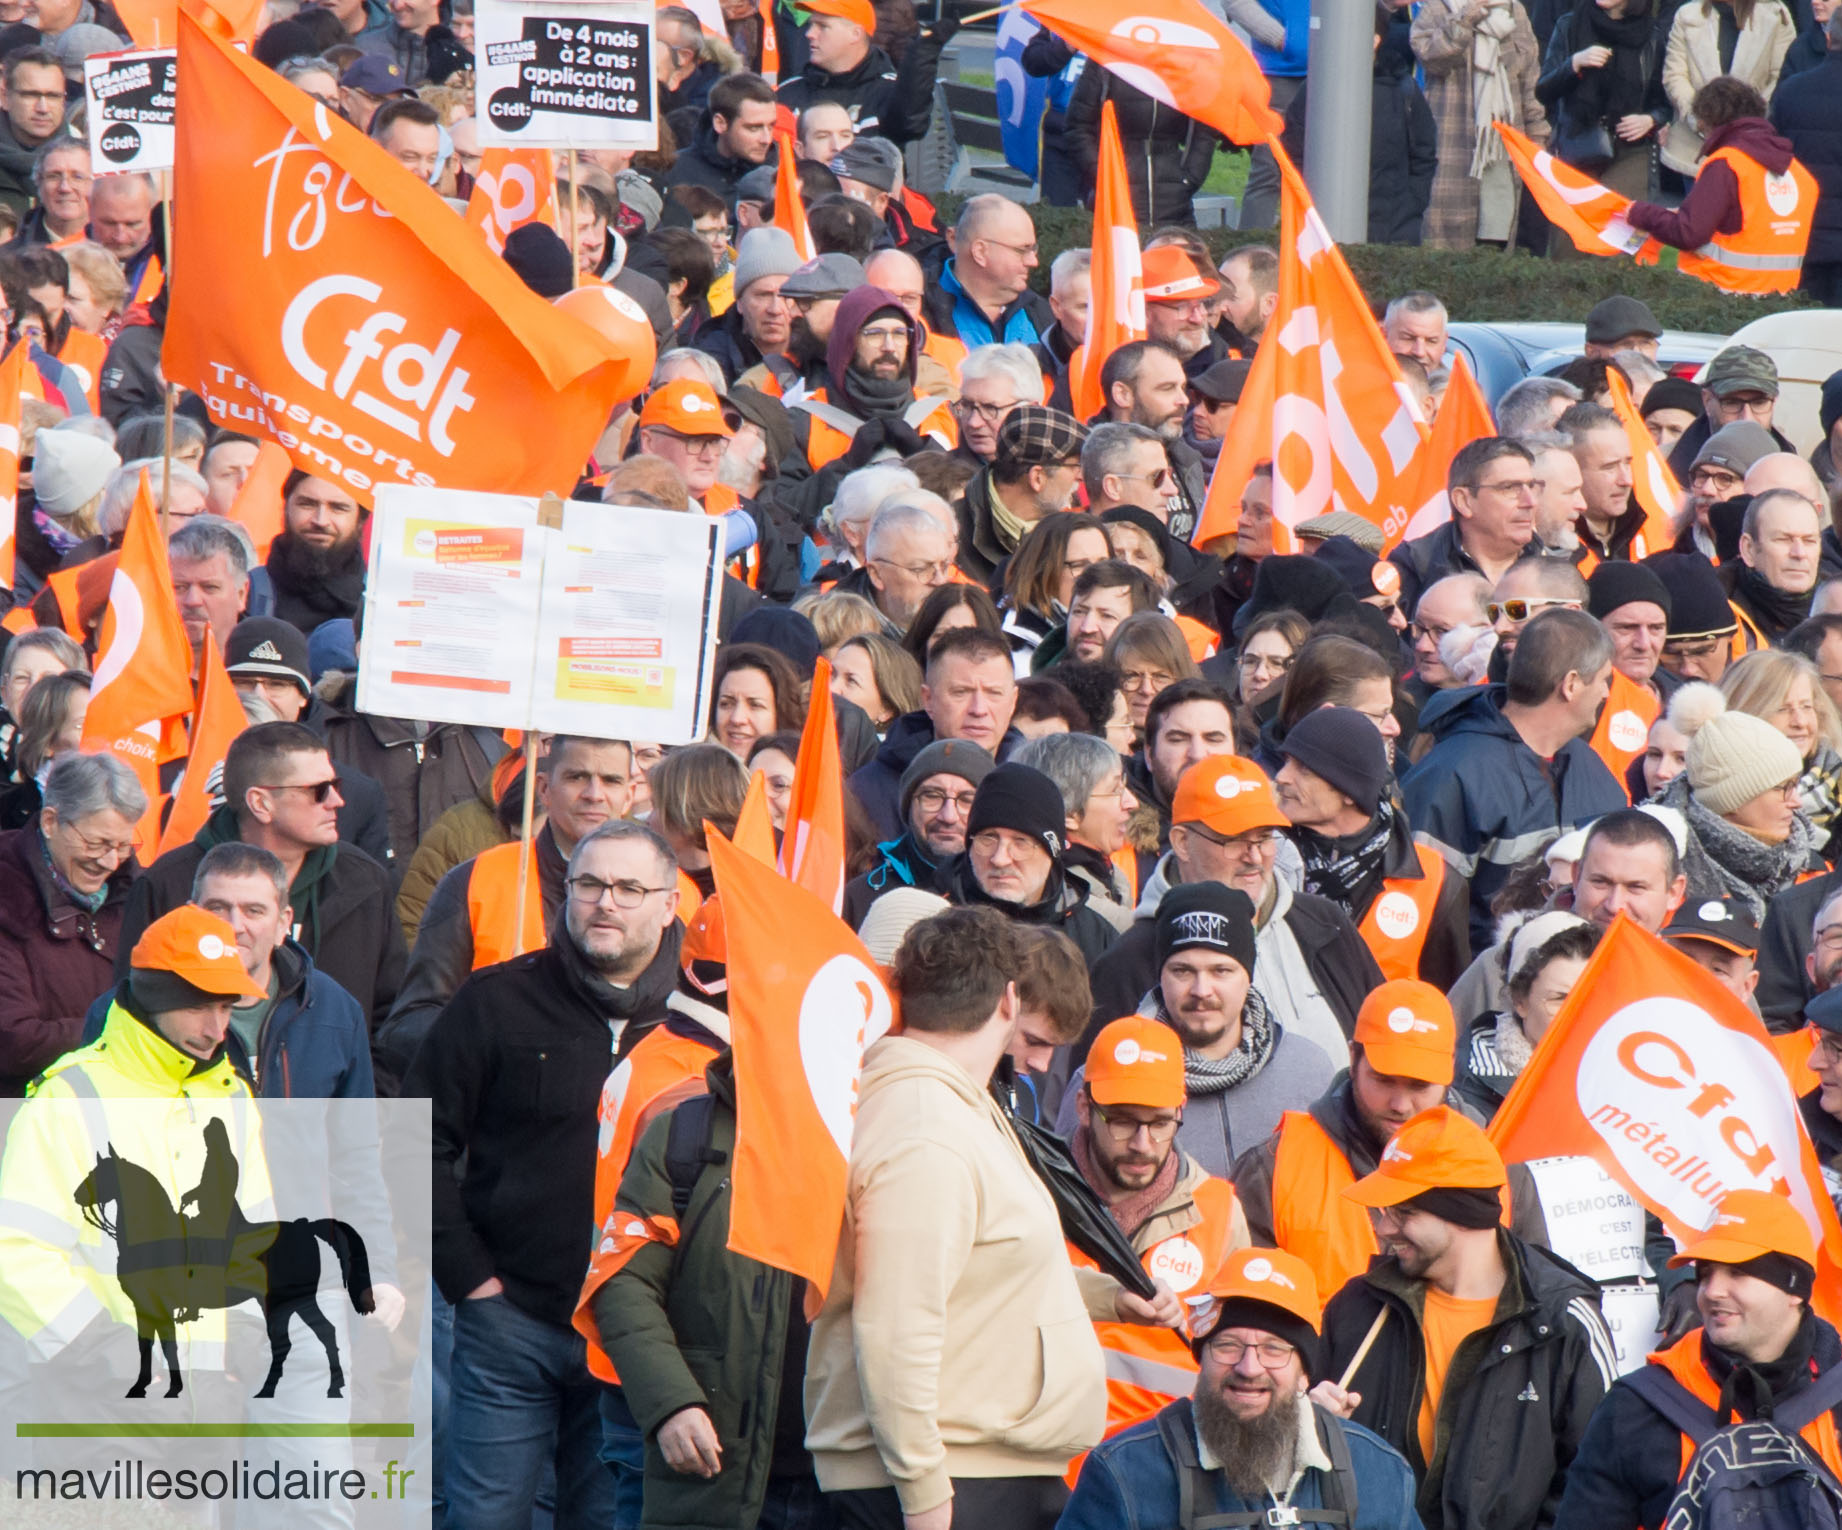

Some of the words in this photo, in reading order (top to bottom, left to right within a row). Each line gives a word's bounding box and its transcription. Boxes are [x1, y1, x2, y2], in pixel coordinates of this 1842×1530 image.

[546, 21, 574, 41] De
[575, 24, 592, 44] 4
[593, 29, 640, 49] mois
[559, 43, 575, 64] à
[576, 46, 591, 66] 2
[522, 66, 637, 92] application
[489, 101, 532, 118] Cfdt:
[529, 85, 640, 114] immédiate
[103, 104, 138, 120] c'est
[138, 109, 174, 123] pour
[101, 135, 140, 151] Cfdt:
[209, 361, 438, 488] Transports
[1599, 1220, 1633, 1236] C'EST
[1155, 1254, 1200, 1279] Cfdt:
